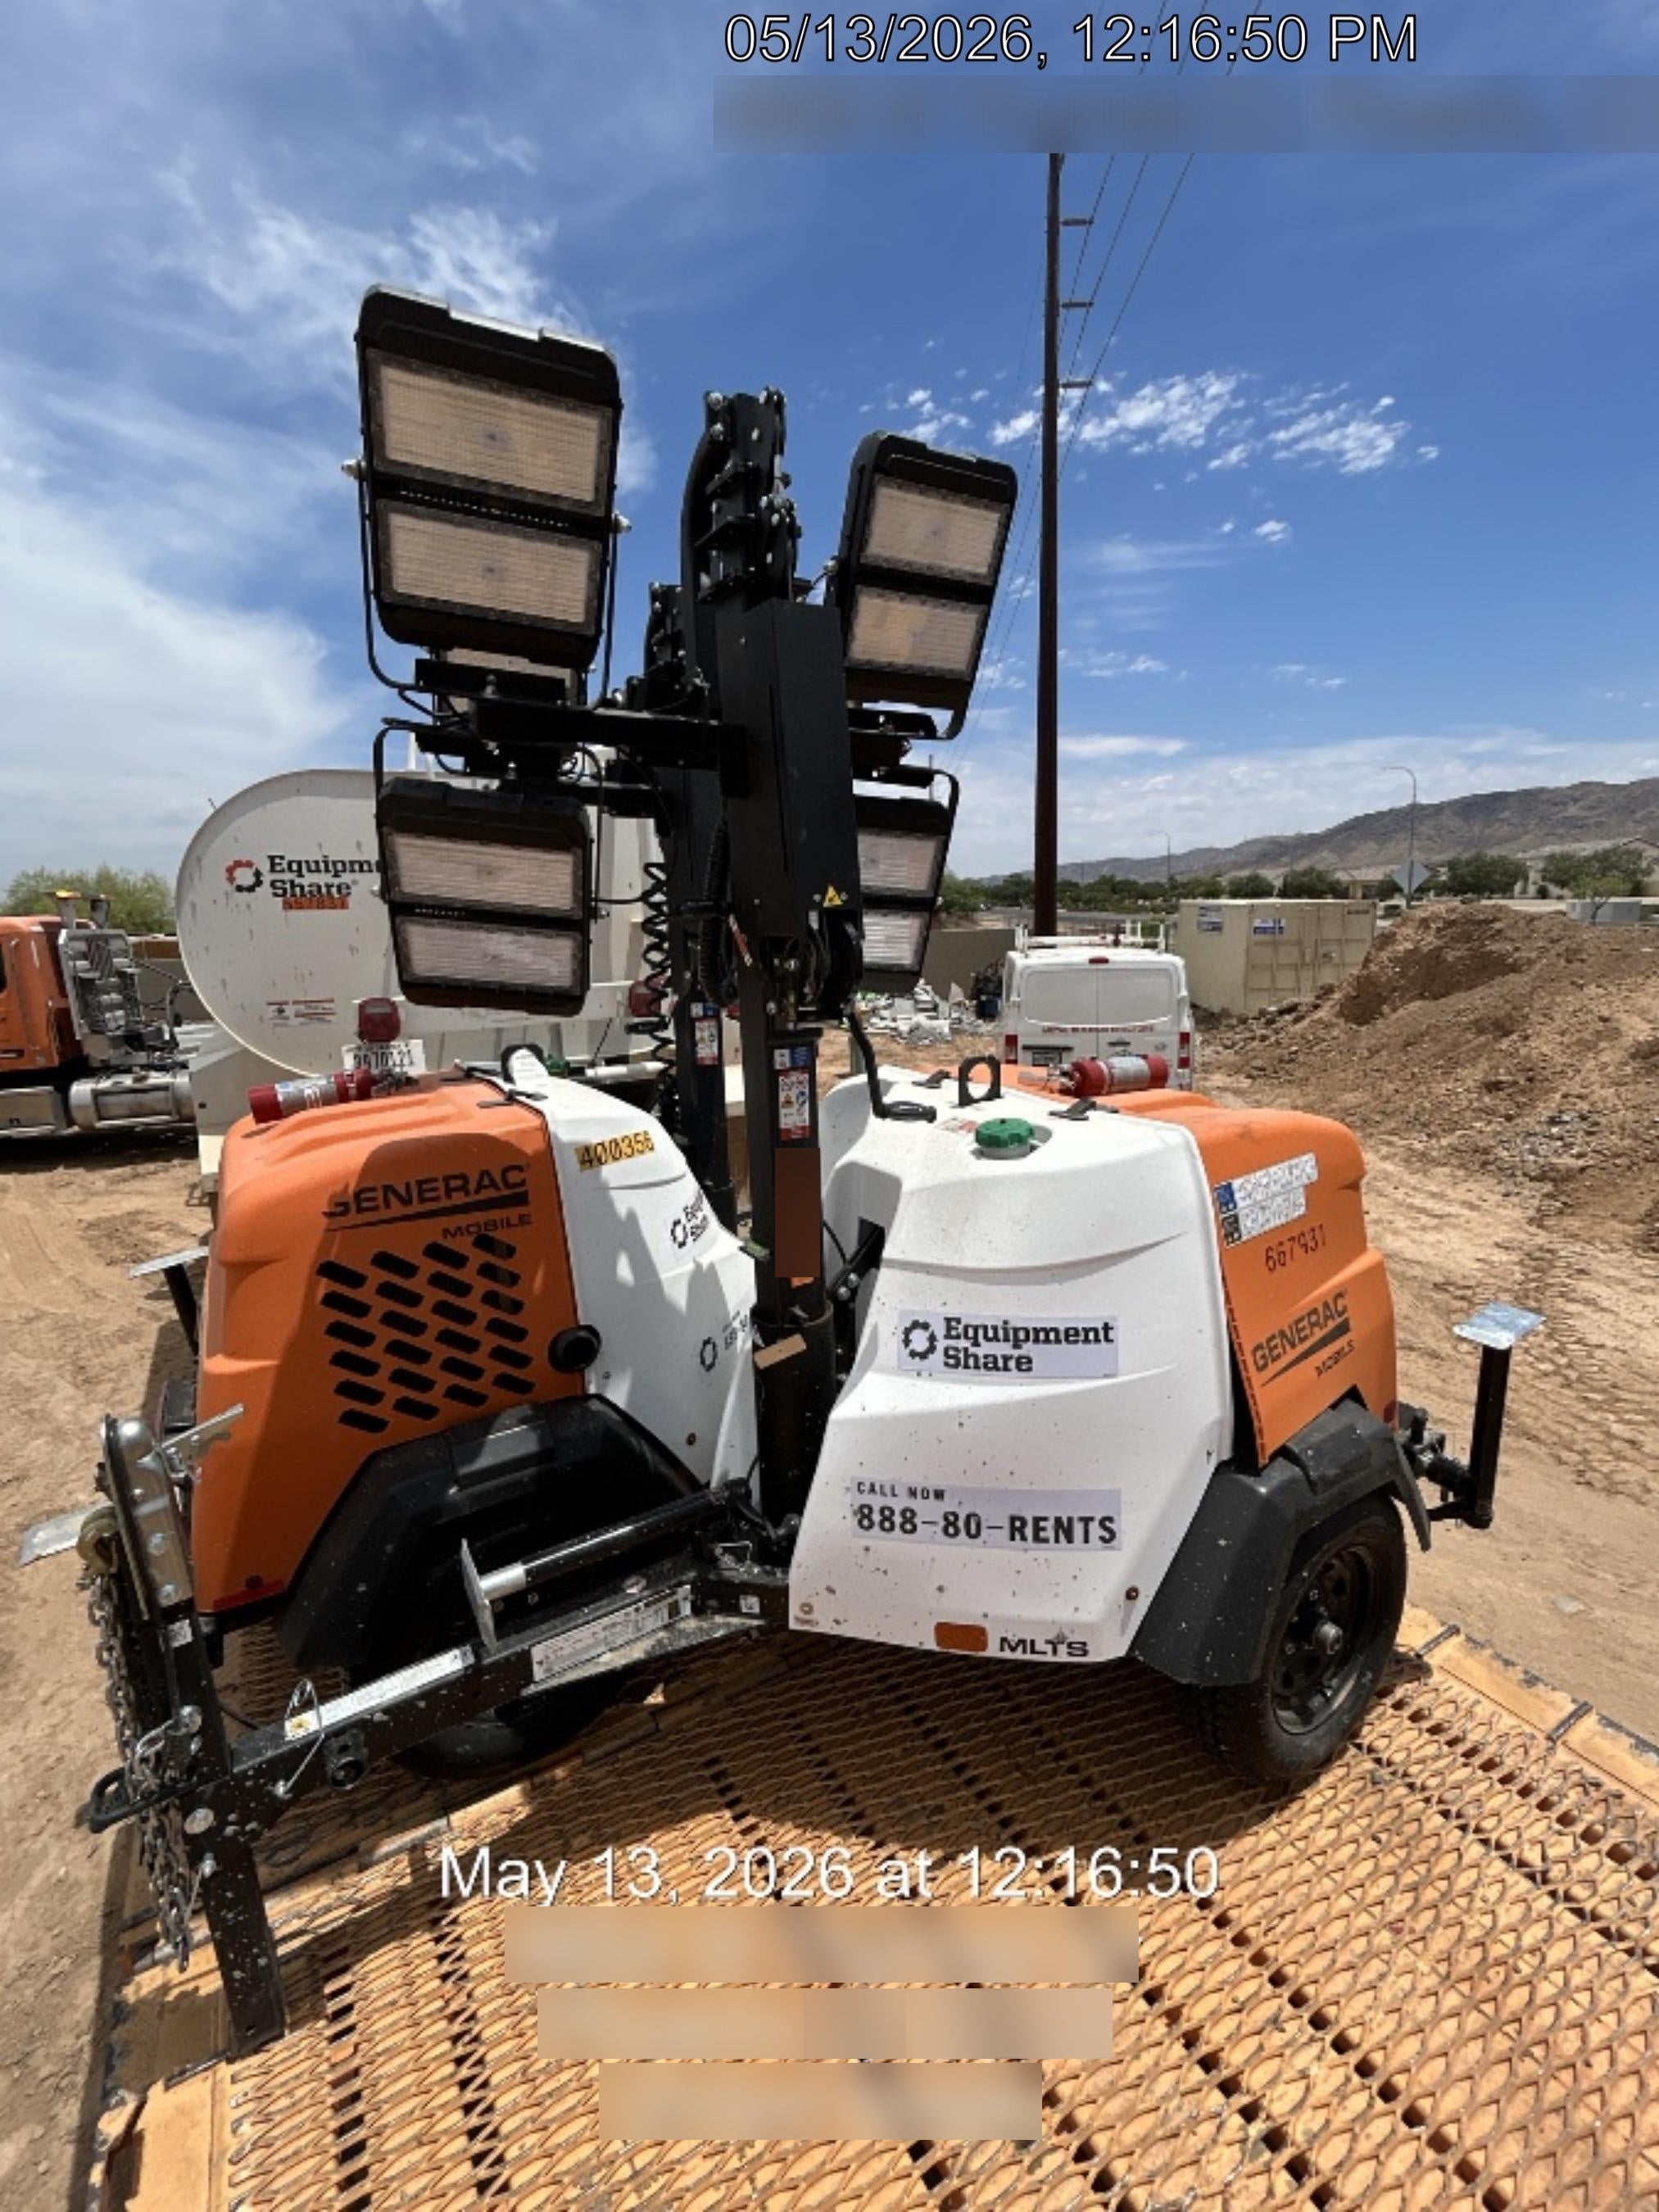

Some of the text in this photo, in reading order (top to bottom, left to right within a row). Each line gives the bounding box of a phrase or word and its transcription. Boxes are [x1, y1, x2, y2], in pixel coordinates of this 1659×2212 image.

[270, 879, 351, 899] Share
[322, 1163, 530, 1219] GENERAC
[442, 1213, 533, 1240] MOBILE
[1265, 1223, 1326, 1272] 667931
[943, 1317, 1114, 1349] Equipment
[1251, 1291, 1349, 1374] GENERAC
[943, 1346, 1033, 1372] Share
[857, 1480, 947, 1501] CALL NOW
[857, 1503, 1117, 1544] 888-80-RENTS
[999, 1636, 1089, 1657] MLTS
